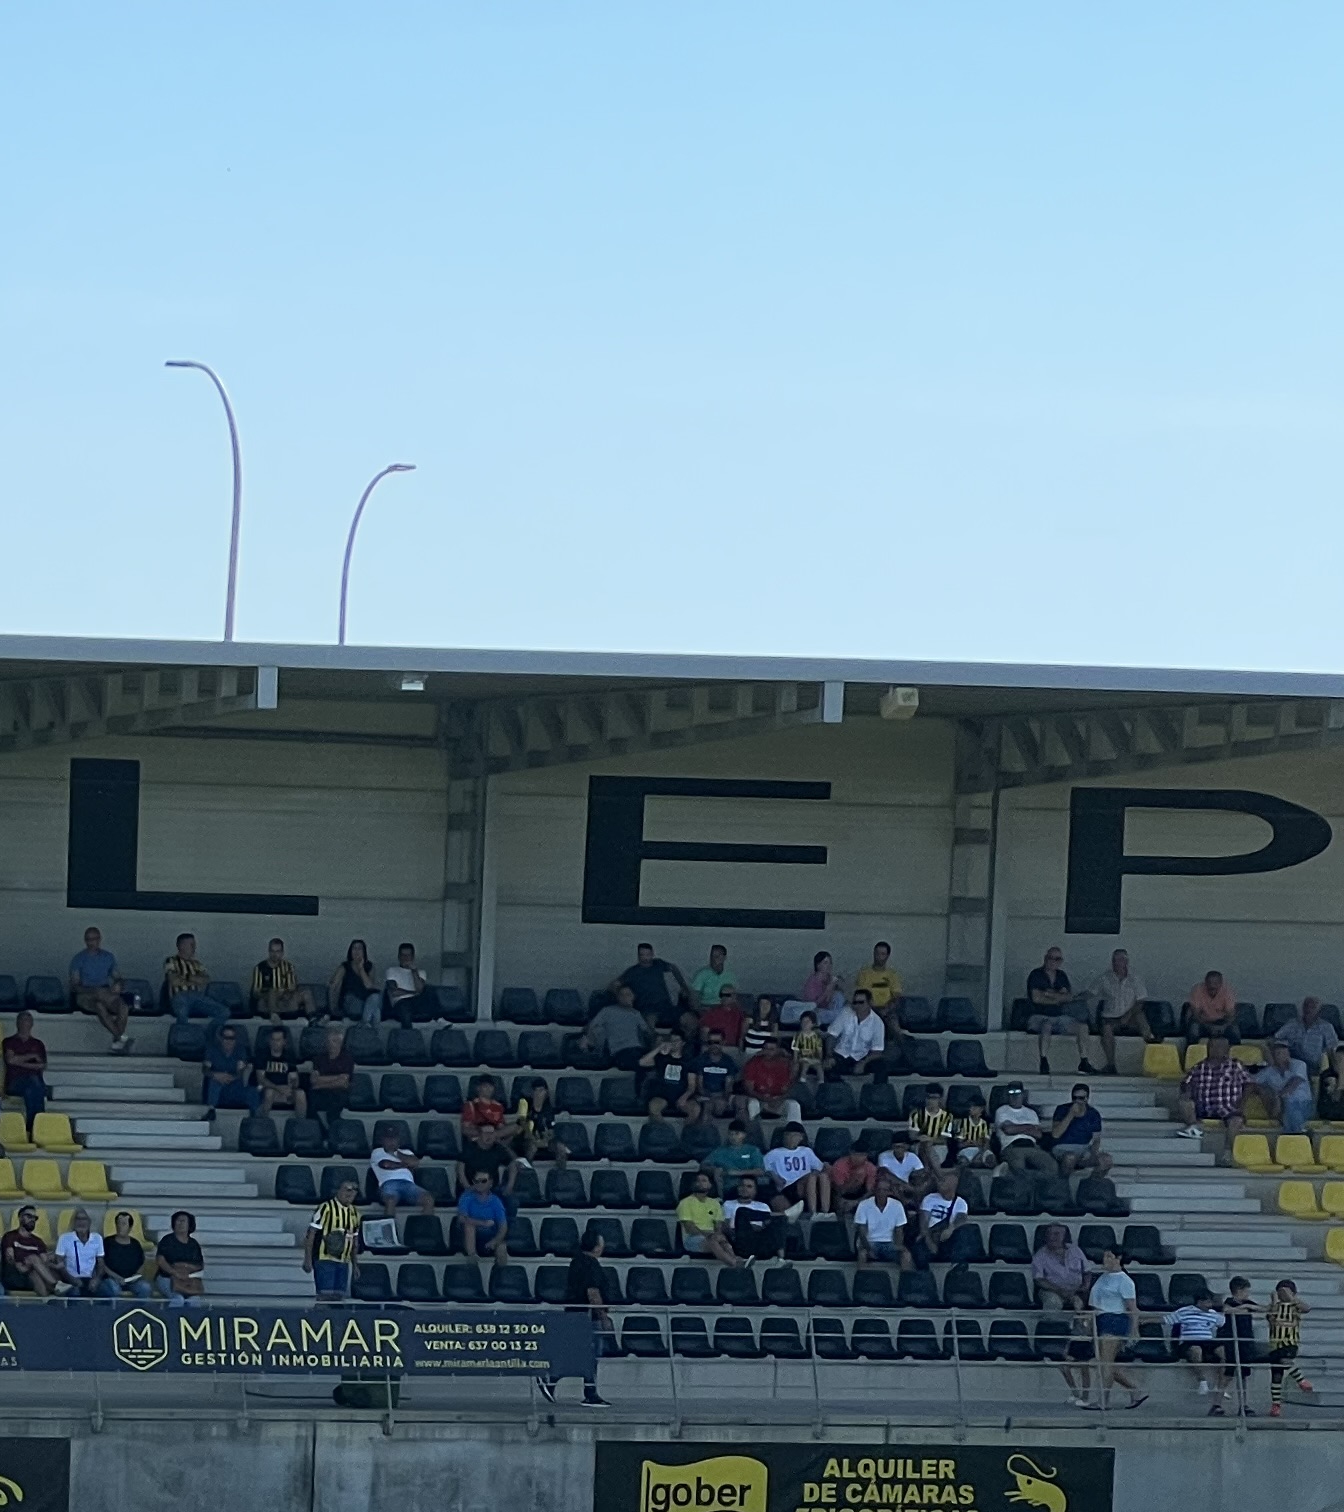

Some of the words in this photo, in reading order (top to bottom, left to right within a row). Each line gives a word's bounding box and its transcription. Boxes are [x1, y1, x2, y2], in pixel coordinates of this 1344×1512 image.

[783, 1156, 807, 1171] 501
[179, 1317, 402, 1353] MIRAMAR
[413, 1323, 473, 1335] ALQUILER:
[475, 1324, 497, 1334] 638
[498, 1324, 511, 1334] 12
[513, 1324, 529, 1334] 30
[530, 1324, 546, 1334] 04
[424, 1340, 466, 1350] VENTA:
[468, 1340, 488, 1351] 637
[490, 1341, 507, 1351] 00
[510, 1341, 522, 1351] 13
[524, 1341, 538, 1351] 23
[181, 1350, 263, 1366] GESTIÓN
[271, 1353, 404, 1368] INMOBILIARIA
[823, 1458, 955, 1480] ALQUILER
[803, 1483, 837, 1503] DE
[845, 1479, 975, 1504] CÁMARAS
